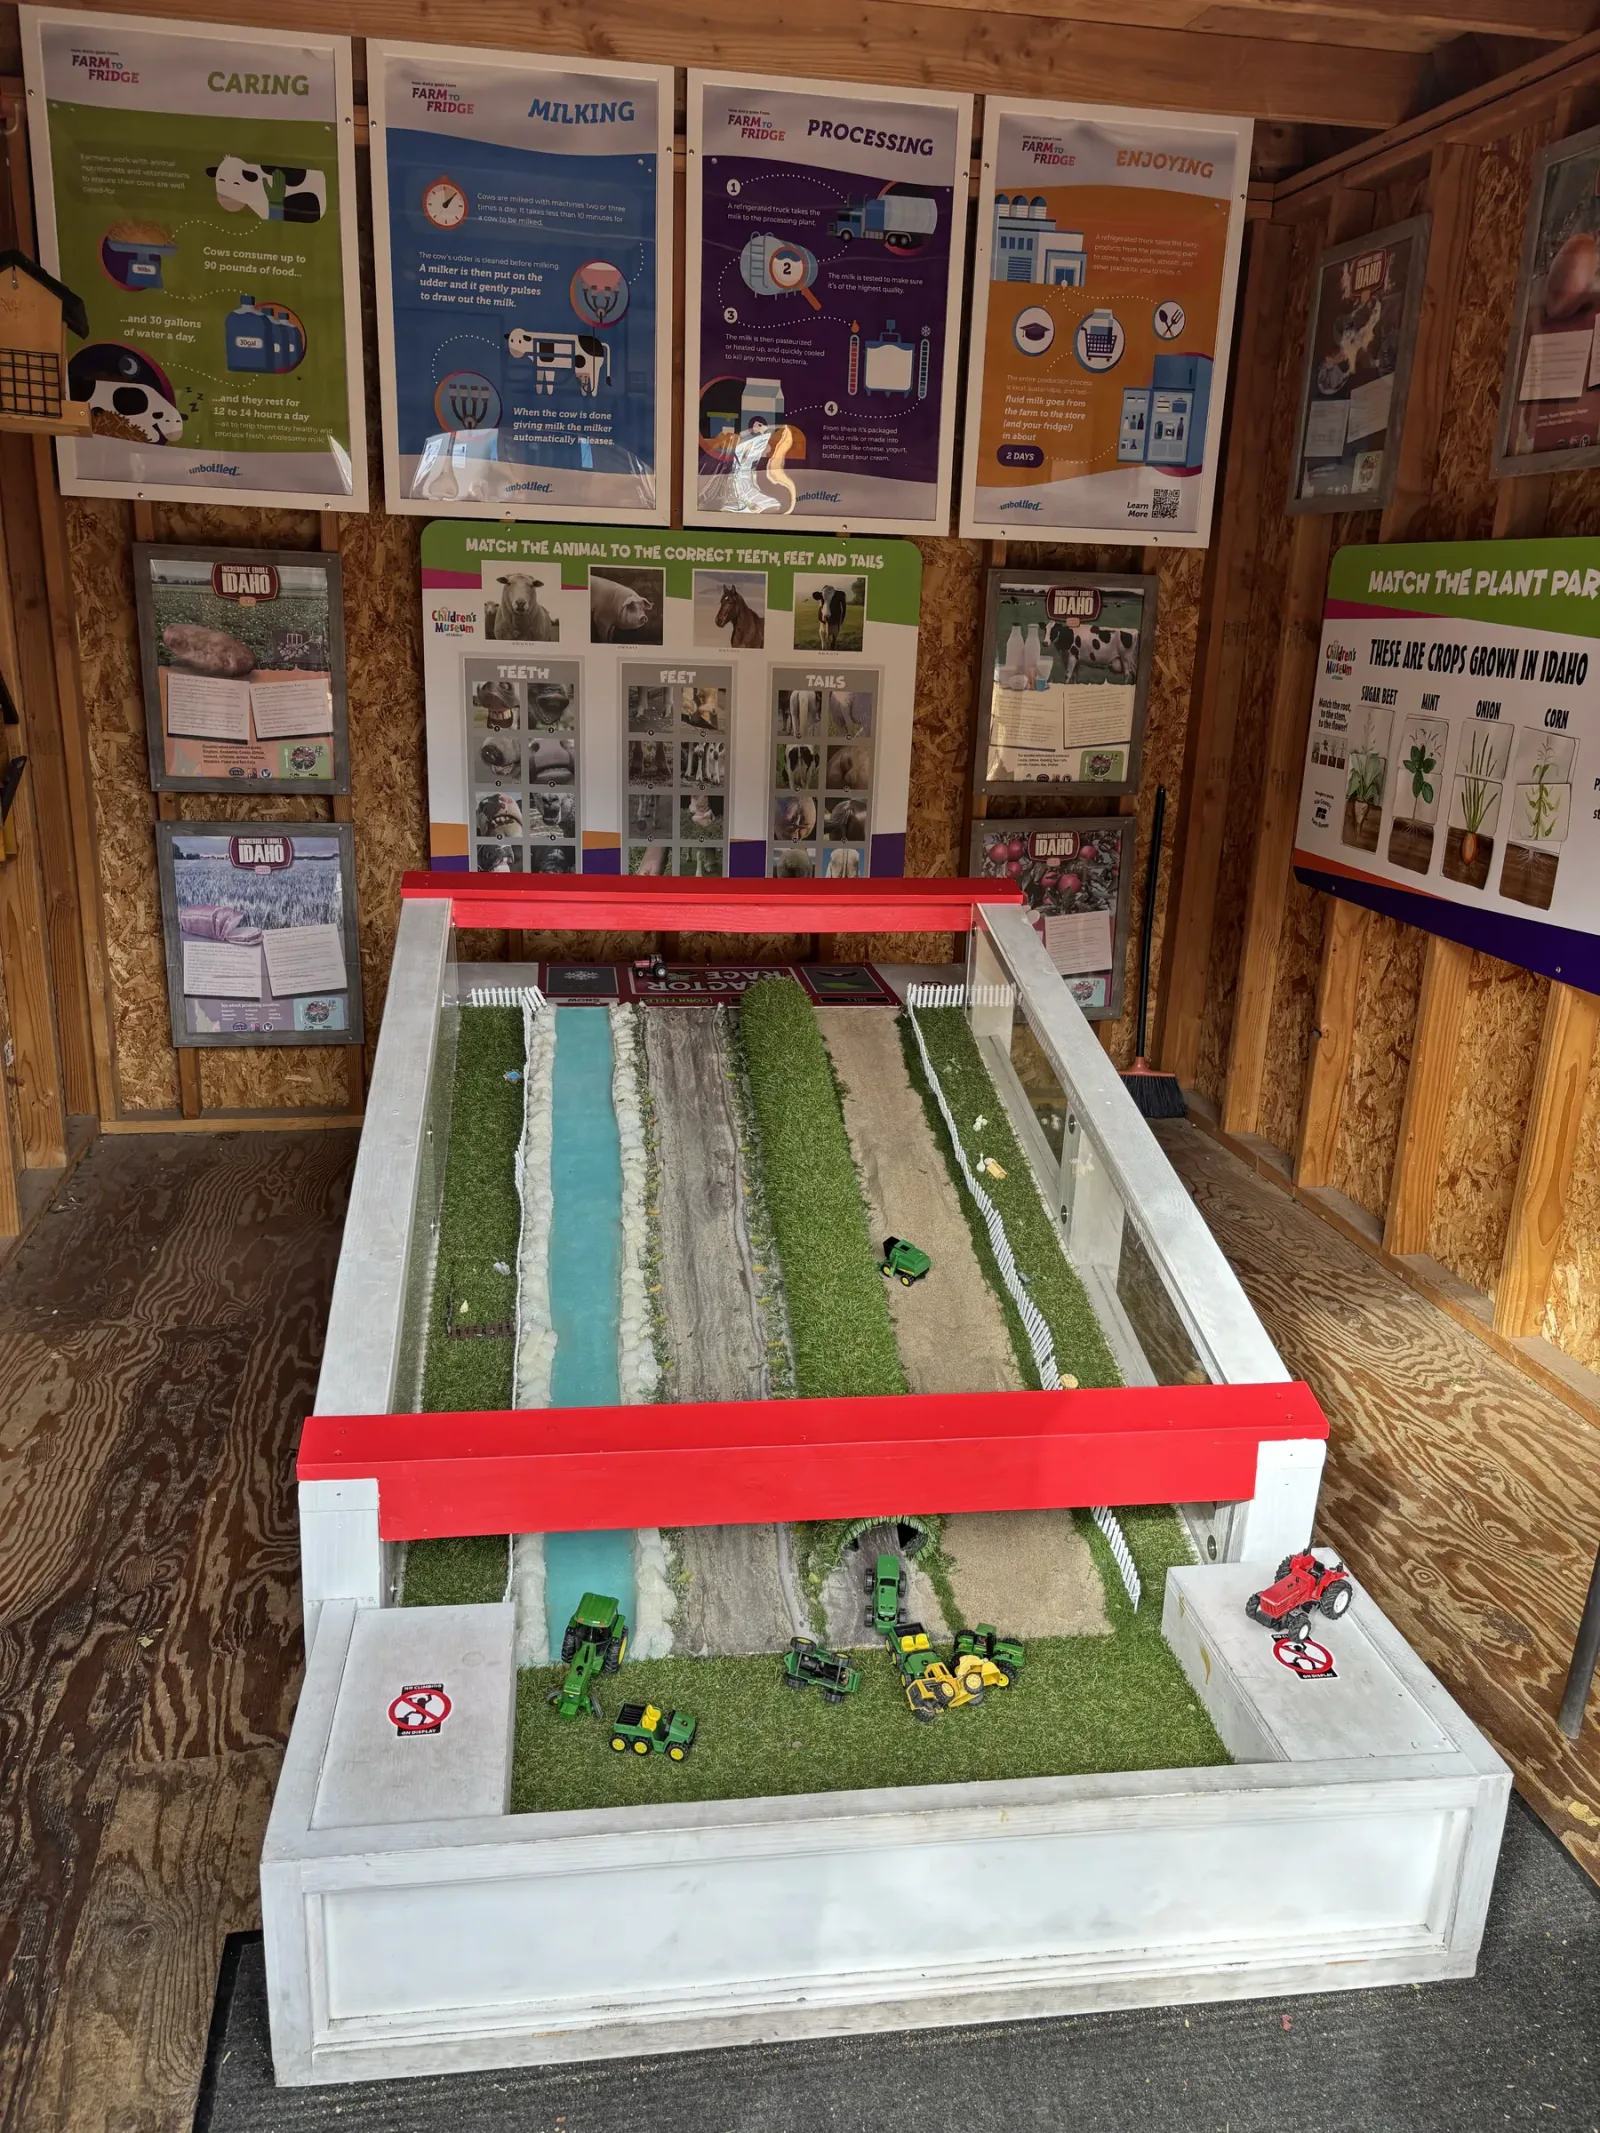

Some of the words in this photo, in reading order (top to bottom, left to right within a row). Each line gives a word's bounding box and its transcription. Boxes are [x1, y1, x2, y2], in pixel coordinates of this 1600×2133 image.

[71, 54, 110, 69] FARM
[111, 61, 123, 70] TO
[88, 69, 140, 84] FRIDGE
[207, 71, 310, 96] CARING
[412, 87, 447, 101] FARM
[426, 101, 475, 115] FRIDGE
[528, 98, 635, 124] MILKING
[727, 114, 761, 128] FARM
[762, 121, 772, 129] TO
[740, 128, 785, 141] FRIDGE
[807, 118, 934, 156] PROCESSING
[1021, 141, 1053, 153] FARM
[1033, 153, 1076, 167] FRIDGE
[1116, 150, 1214, 179] ENJOYING
[730, 183, 737, 192] 1
[203, 246, 231, 258] Cows
[233, 251, 278, 261] consume
[281, 254, 293, 265] up
[295, 255, 306, 264] to
[418, 251, 430, 259] The
[432, 253, 451, 261] cow's
[452, 254, 473, 263] udder
[482, 256, 508, 265] cleaned
[510, 258, 532, 267] before
[204, 261, 217, 270] 90
[219, 262, 257, 274] pounds
[260, 265, 272, 275] of
[419, 264, 426, 272] A
[428, 264, 458, 274] milker
[460, 266, 468, 275] is
[470, 268, 492, 278] then
[494, 270, 511, 281] put
[527, 272, 543, 282] the
[782, 262, 791, 275] 2
[1355, 264, 1382, 291] IDAHO
[420, 279, 448, 289] udder
[450, 280, 467, 290] and
[469, 281, 477, 291] it
[479, 282, 508, 295] gently
[511, 285, 541, 296] pulses
[420, 292, 430, 301] to
[432, 292, 455, 303] draw
[457, 295, 474, 304] out
[475, 295, 491, 305] the
[493, 297, 517, 308] milk.
[149, 316, 162, 325] 30
[164, 317, 202, 329] gallons
[727, 311, 735, 320] 3
[124, 327, 134, 337] of
[136, 329, 166, 339] water
[239, 339, 257, 348] 30gal
[241, 396, 264, 408] they
[266, 398, 283, 407] rest
[285, 398, 300, 408] for
[827, 404, 835, 413] 4
[1005, 394, 1024, 404] fluid
[1026, 396, 1044, 405] milk
[1045, 399, 1064, 409] goes
[1066, 398, 1086, 408] from
[213, 407, 225, 416] 12
[227, 408, 238, 417] to
[240, 408, 251, 418] 14
[254, 409, 282, 420] hours
[283, 412, 290, 420] a
[292, 411, 310, 423] day
[513, 407, 540, 417] When
[542, 408, 556, 418] the
[558, 411, 577, 419] cow
[579, 410, 587, 419] is
[588, 410, 612, 421] done
[1004, 407, 1017, 416] the
[1018, 408, 1038, 418] farm
[1040, 409, 1048, 418] to
[1050, 410, 1063, 419] the
[1064, 411, 1086, 420] store
[513, 421, 543, 431] giving
[544, 422, 565, 431] milk
[566, 423, 581, 432] the
[583, 424, 612, 433] milker
[1003, 419, 1021, 429] (and
[1022, 421, 1042, 431] your
[513, 434, 576, 445] automatically
[577, 437, 615, 446] releases.
[1002, 432, 1010, 440] in
[1012, 432, 1036, 441] about
[1006, 452, 1012, 460] 2
[1013, 452, 1034, 461] DAYS
[1126, 501, 1149, 510] Learn
[1127, 510, 1149, 519] More
[465, 537, 518, 555] MATCH
[520, 540, 549, 556] THE
[552, 542, 607, 558] ANIMAL
[609, 543, 632, 559] TO
[634, 544, 661, 560] THE
[664, 546, 734, 563] CORRECT
[737, 548, 782, 567] TEETH,
[783, 551, 814, 566] FEET
[817, 553, 847, 567] AND
[850, 553, 884, 570] TAILS
[222, 565, 250, 573] INCREDIBLE
[251, 566, 269, 574] EDIBLE
[222, 573, 270, 594] IDAHO
[1367, 569, 1431, 594] MATCH
[1433, 568, 1473, 596] THE
[1475, 568, 1548, 597] PLANT
[1053, 596, 1094, 616] IDAHO
[431, 608, 477, 624] Children's
[434, 622, 475, 634] Museum
[1326, 643, 1357, 662] Children's
[1325, 660, 1353, 676] Museum
[1370, 639, 1402, 668] THESE
[1403, 642, 1426, 672] ARE
[1427, 643, 1467, 675] CROPS
[1469, 646, 1520, 680] GROWN
[1520, 649, 1540, 682] IN
[1540, 650, 1589, 686] IDAHO
[497, 664, 550, 680] TEETH
[660, 670, 697, 684] FEET
[805, 674, 846, 689] TAILS
[1360, 685, 1380, 704] SUGAR
[1381, 688, 1398, 706] BEET
[1420, 692, 1440, 712] MINT
[1475, 699, 1502, 720] ONION
[1544, 707, 1570, 730] CORN
[238, 844, 285, 863] IDAHO
[1035, 838, 1074, 857] IDAHO
